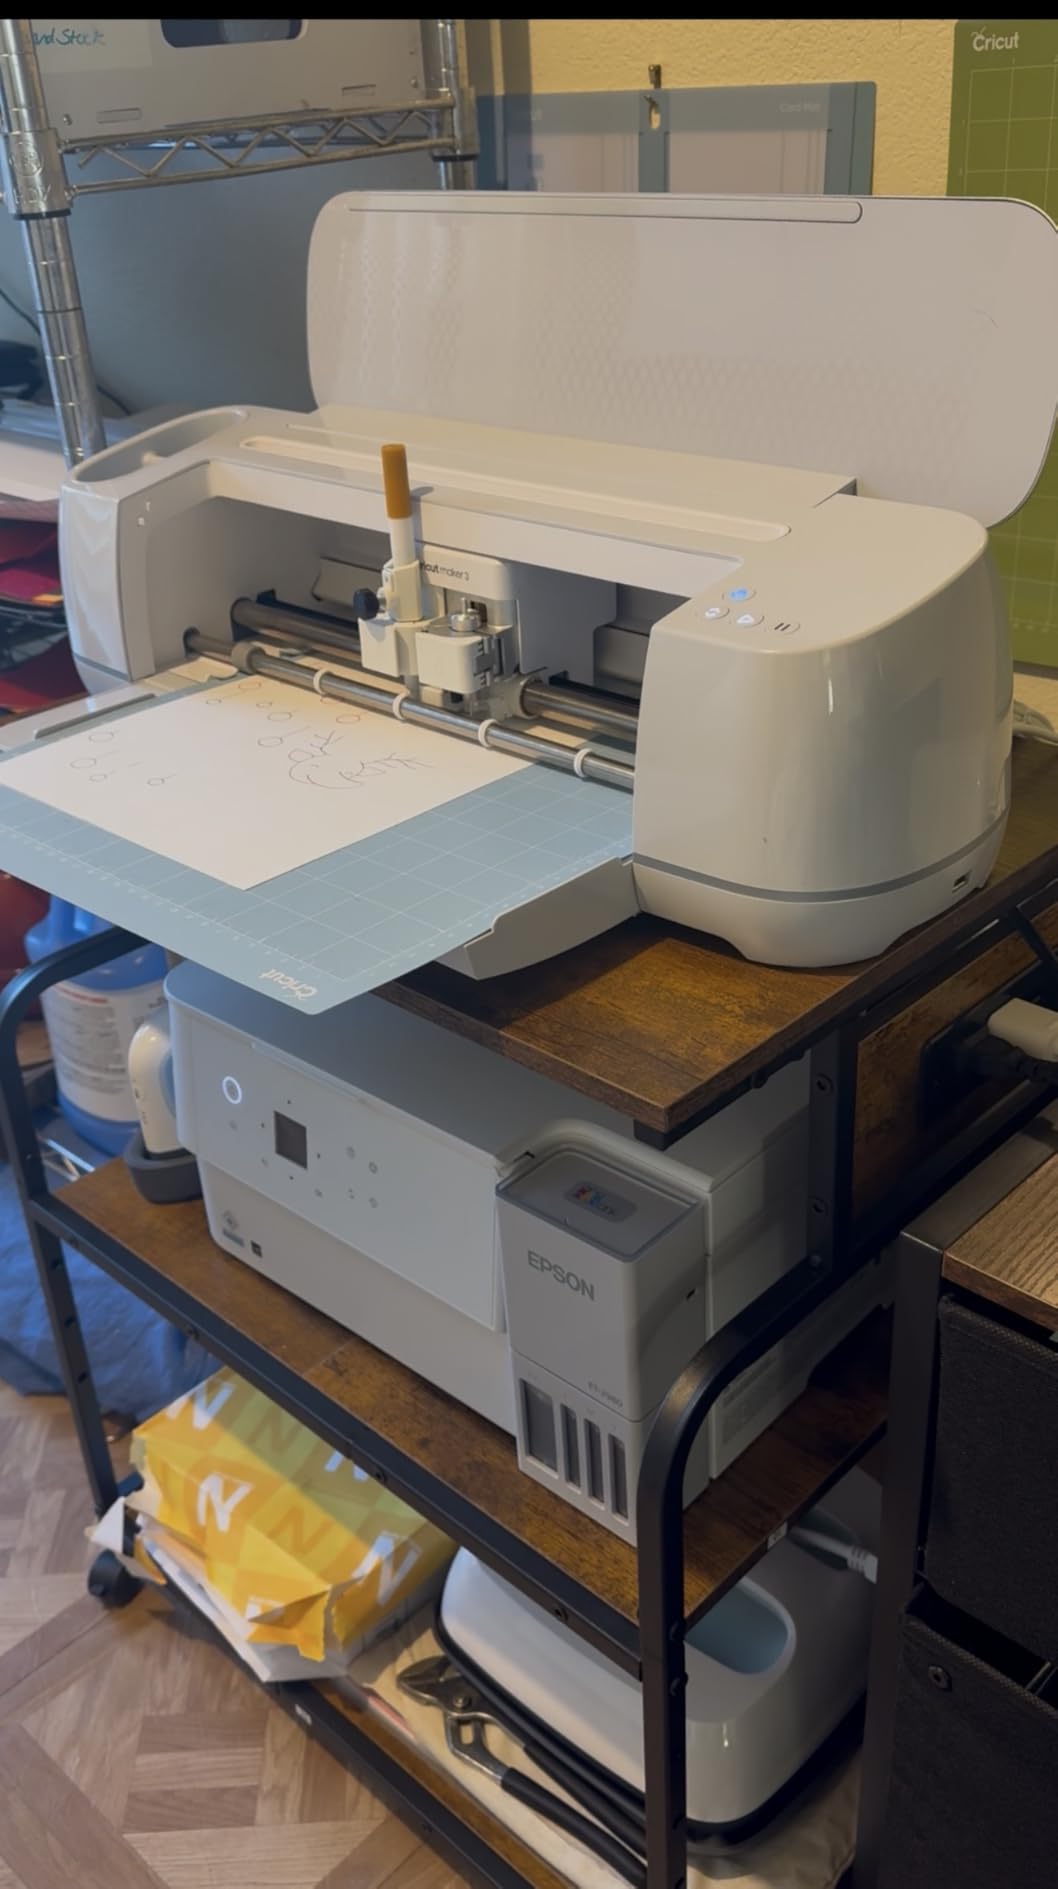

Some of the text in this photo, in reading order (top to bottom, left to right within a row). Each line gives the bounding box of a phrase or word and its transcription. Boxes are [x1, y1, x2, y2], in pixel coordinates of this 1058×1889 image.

[56, 27, 106, 46] Stock
[971, 26, 1020, 52] Cricut
[257, 968, 318, 1000] Cricut
[527, 1250, 595, 1301] EPSON
[196, 1471, 255, 1532] N
